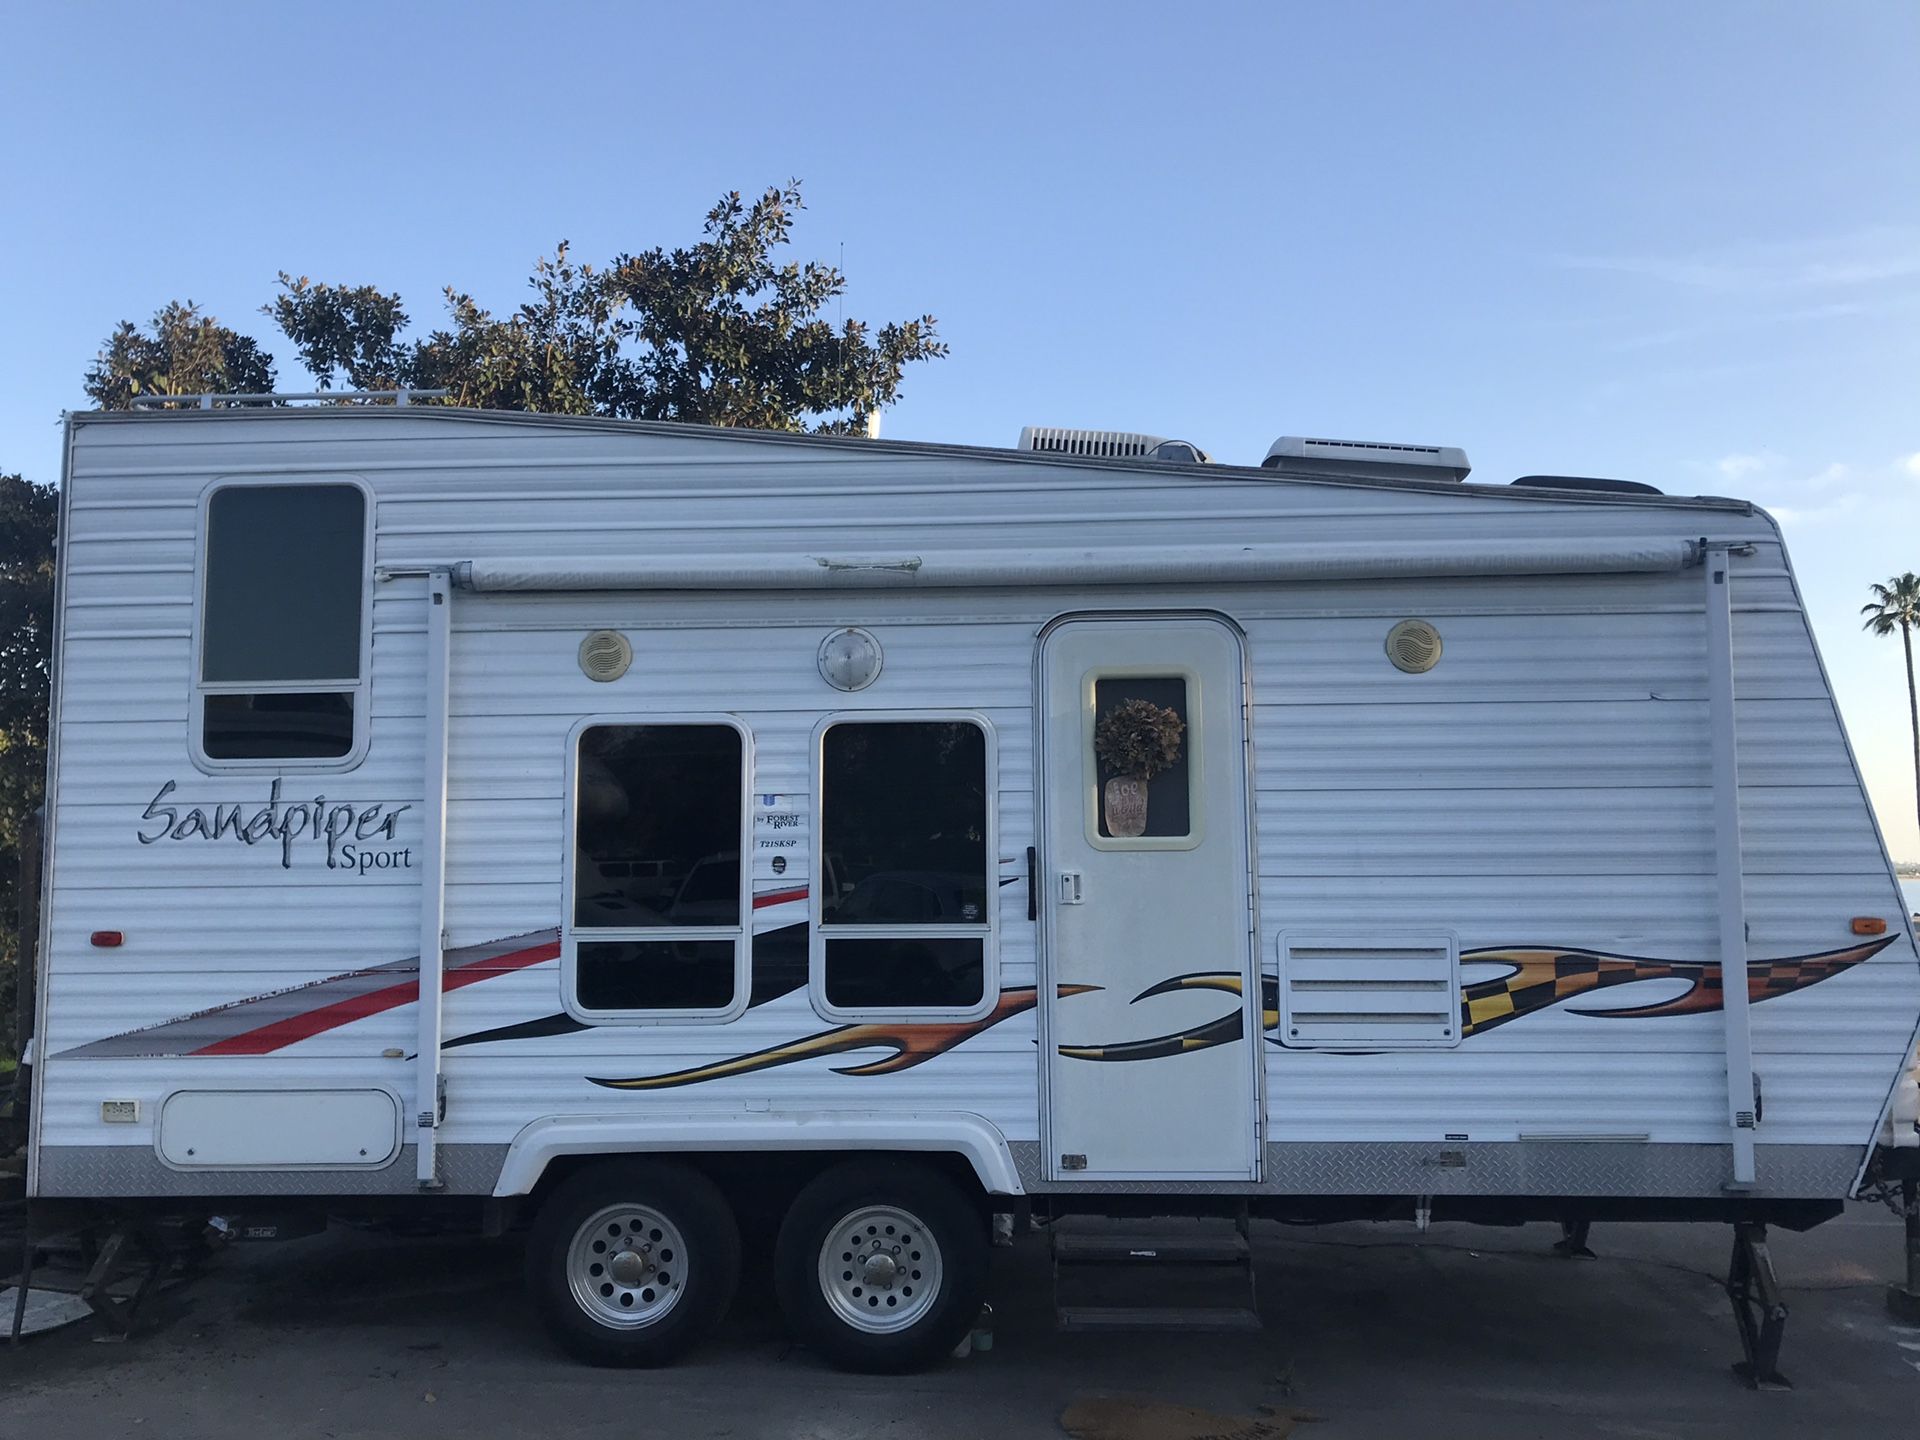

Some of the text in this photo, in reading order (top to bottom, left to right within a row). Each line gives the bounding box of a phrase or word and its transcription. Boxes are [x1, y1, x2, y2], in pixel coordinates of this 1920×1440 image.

[137, 777, 412, 869] Sandpiper
[767, 815, 799, 824] FOREST
[774, 821, 798, 829] RIVER
[760, 840, 797, 848] T21SKSP
[340, 844, 413, 876] Sport
